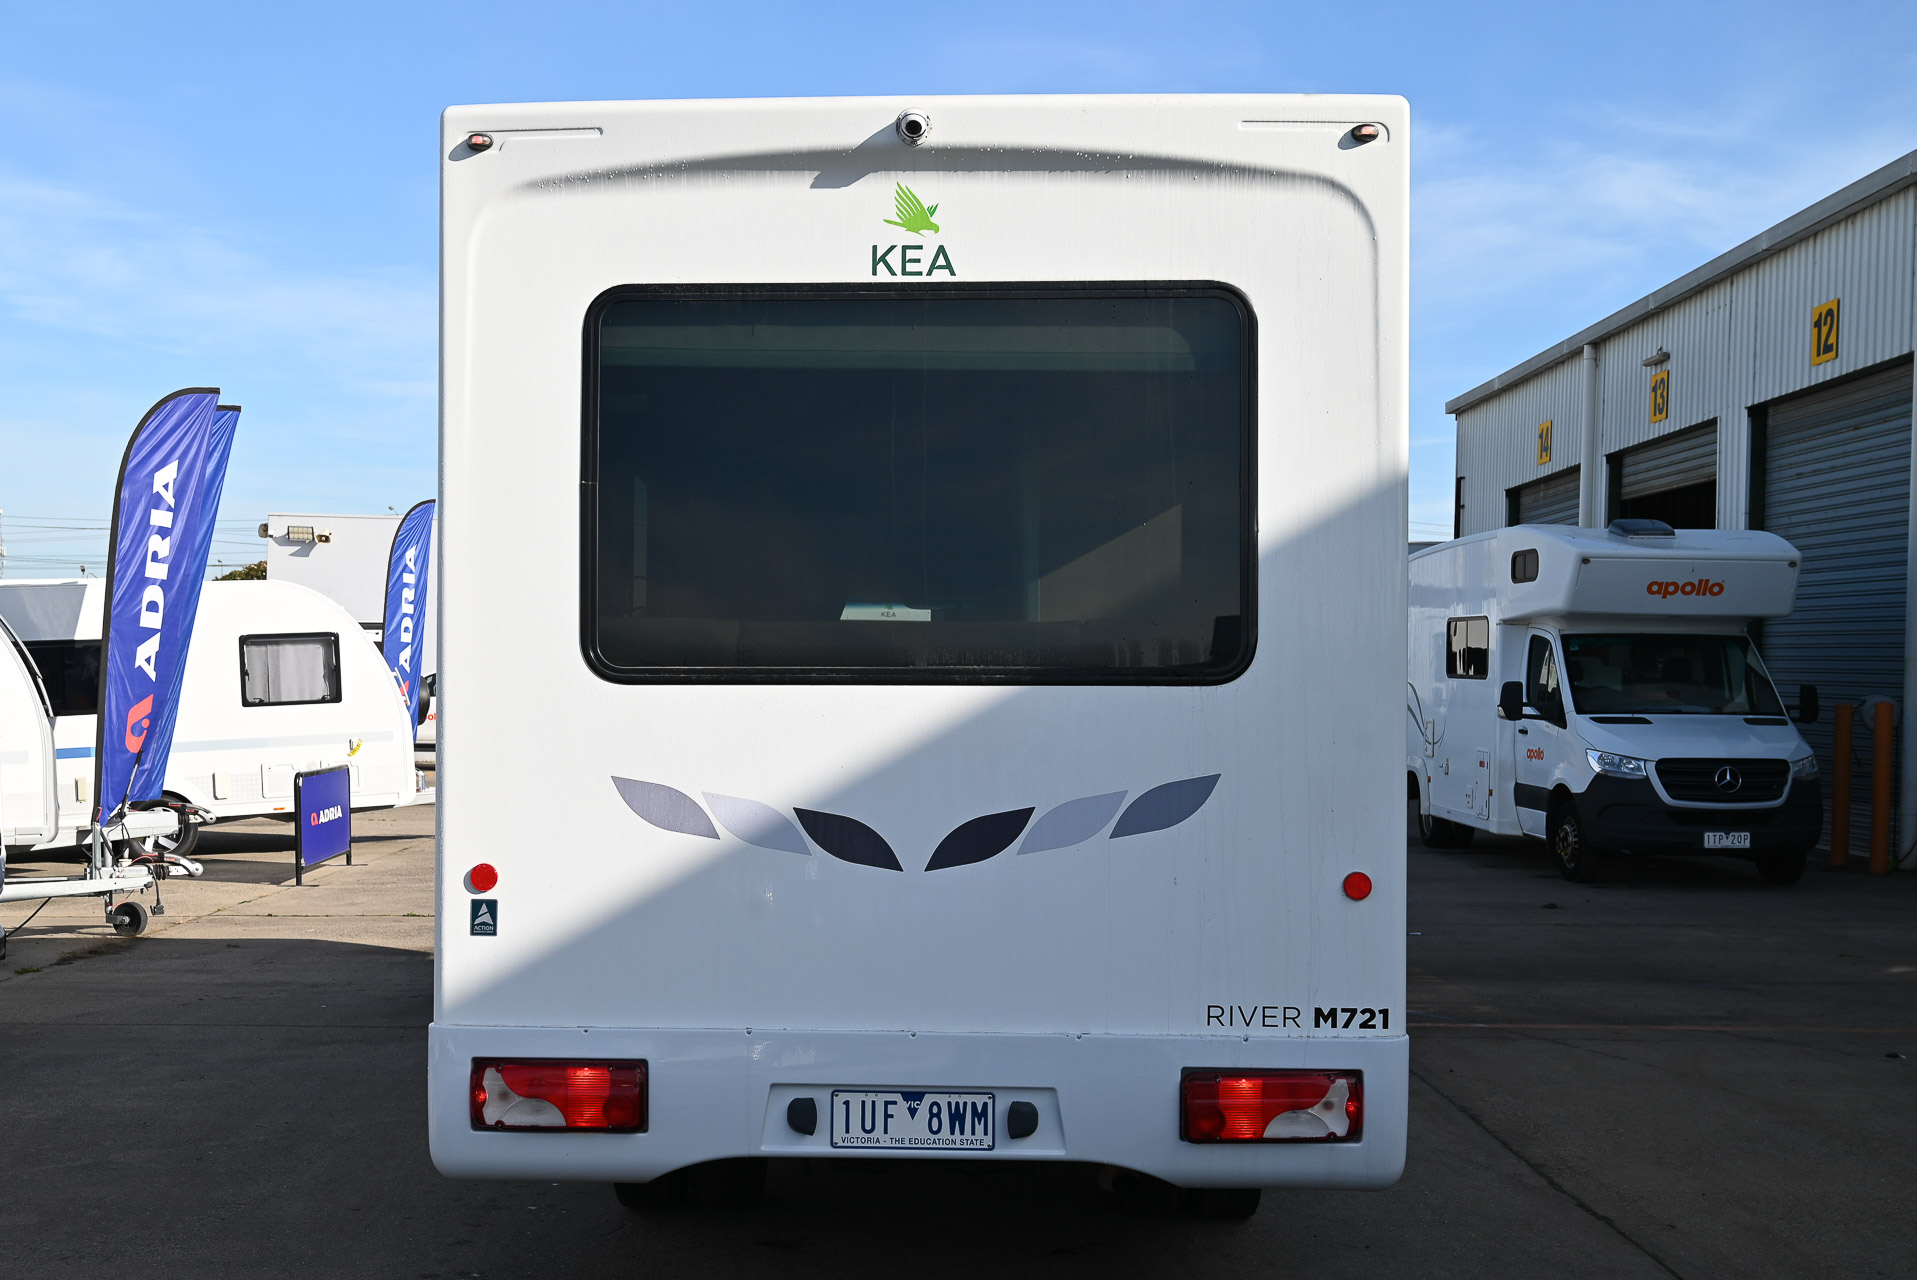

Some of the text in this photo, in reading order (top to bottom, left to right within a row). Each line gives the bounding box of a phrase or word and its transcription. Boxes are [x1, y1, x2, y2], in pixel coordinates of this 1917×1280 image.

[871, 244, 957, 277] KEA
[1813, 308, 1835, 357] 12
[1652, 377, 1666, 417] 13
[1539, 425, 1549, 459] 14
[134, 459, 179, 682] ADRIA
[1646, 578, 1725, 600] apollo
[399, 544, 417, 673] ADRIA
[1526, 747, 1545, 762] apollo
[319, 805, 343, 824] ADRIA
[1207, 1005, 1390, 1030] RIVER M721
[842, 1099, 989, 1137] 1UF 8WM
[905, 1100, 921, 1109] VIC
[841, 1136, 881, 1145] VICTORIA
[889, 1137, 906, 1145] THE
[908, 1137, 957, 1146] EDUCATION
[959, 1138, 985, 1146] STATE
